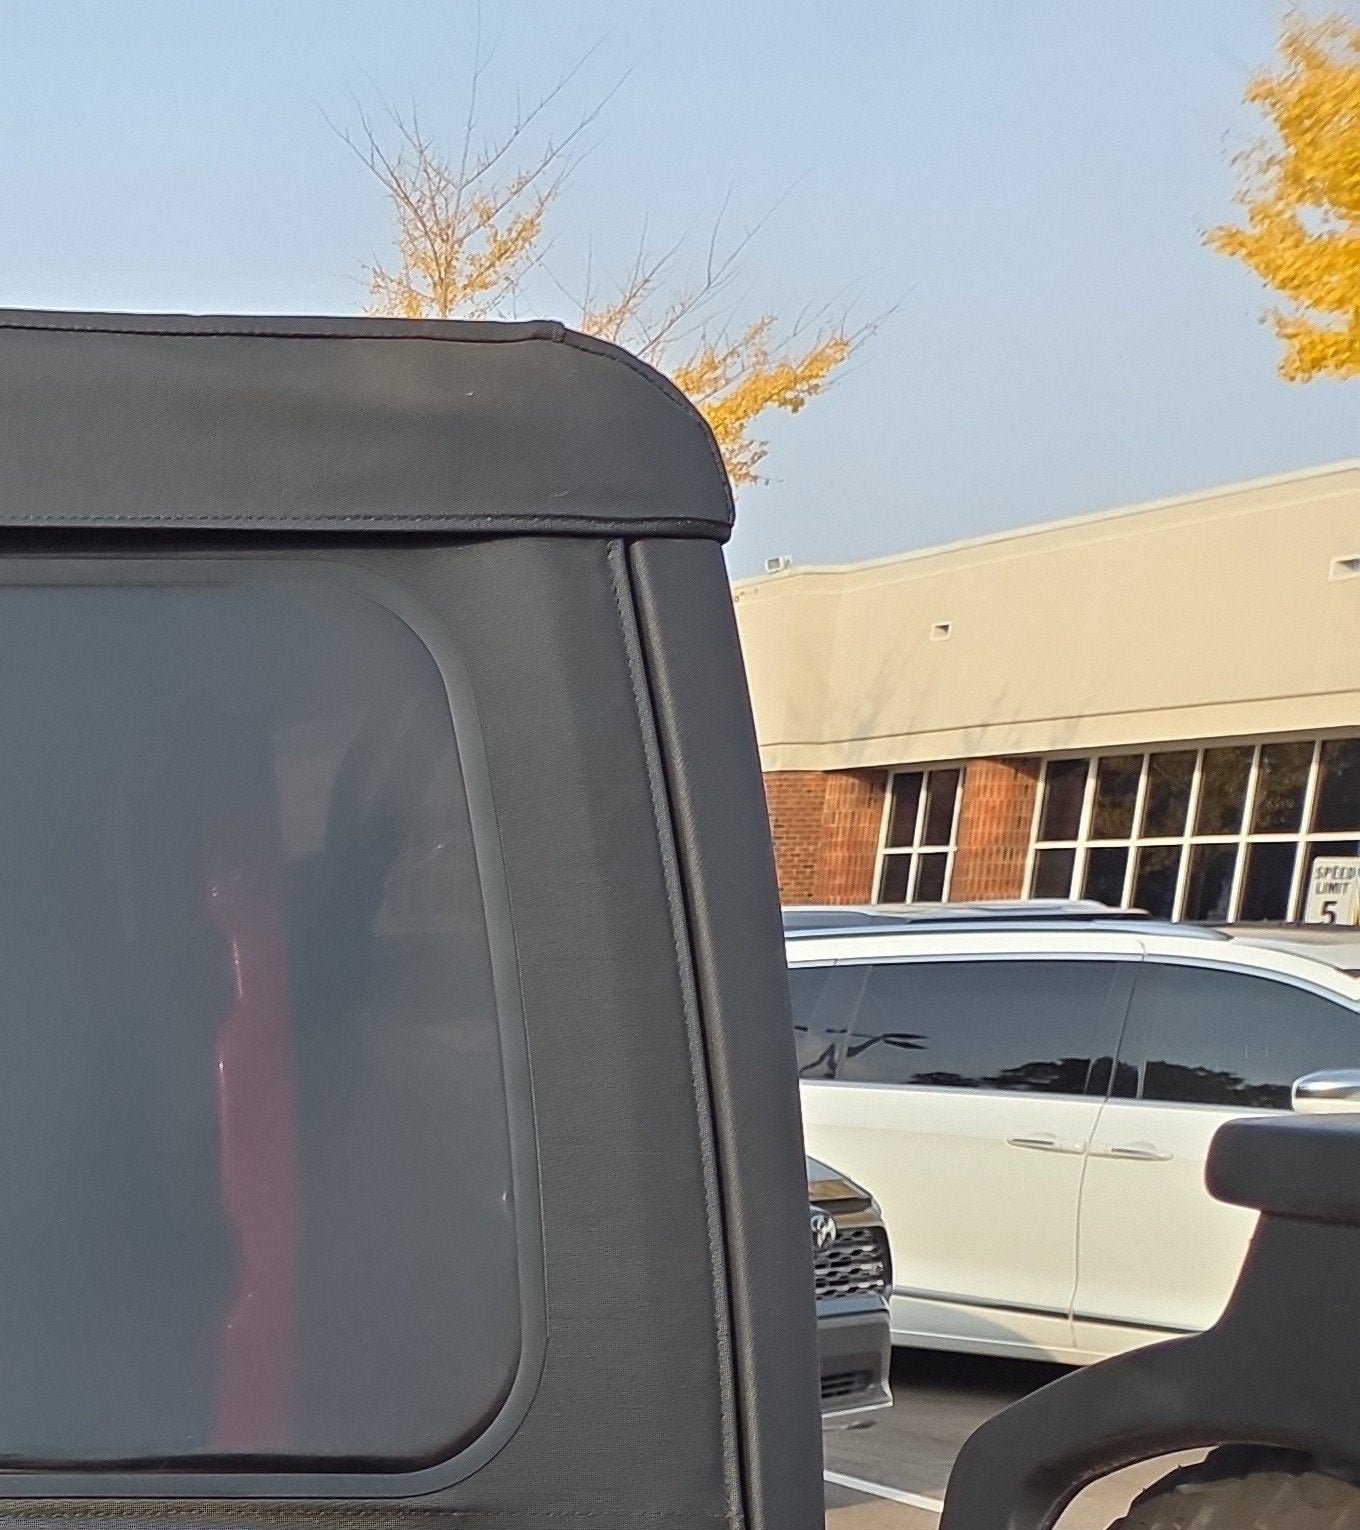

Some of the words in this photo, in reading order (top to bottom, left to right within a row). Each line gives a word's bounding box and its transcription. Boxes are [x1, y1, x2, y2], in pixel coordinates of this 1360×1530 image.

[1314, 865, 1356, 879] SPEED
[1314, 882, 1351, 895] LIMIT
[1320, 900, 1338, 924] 5
